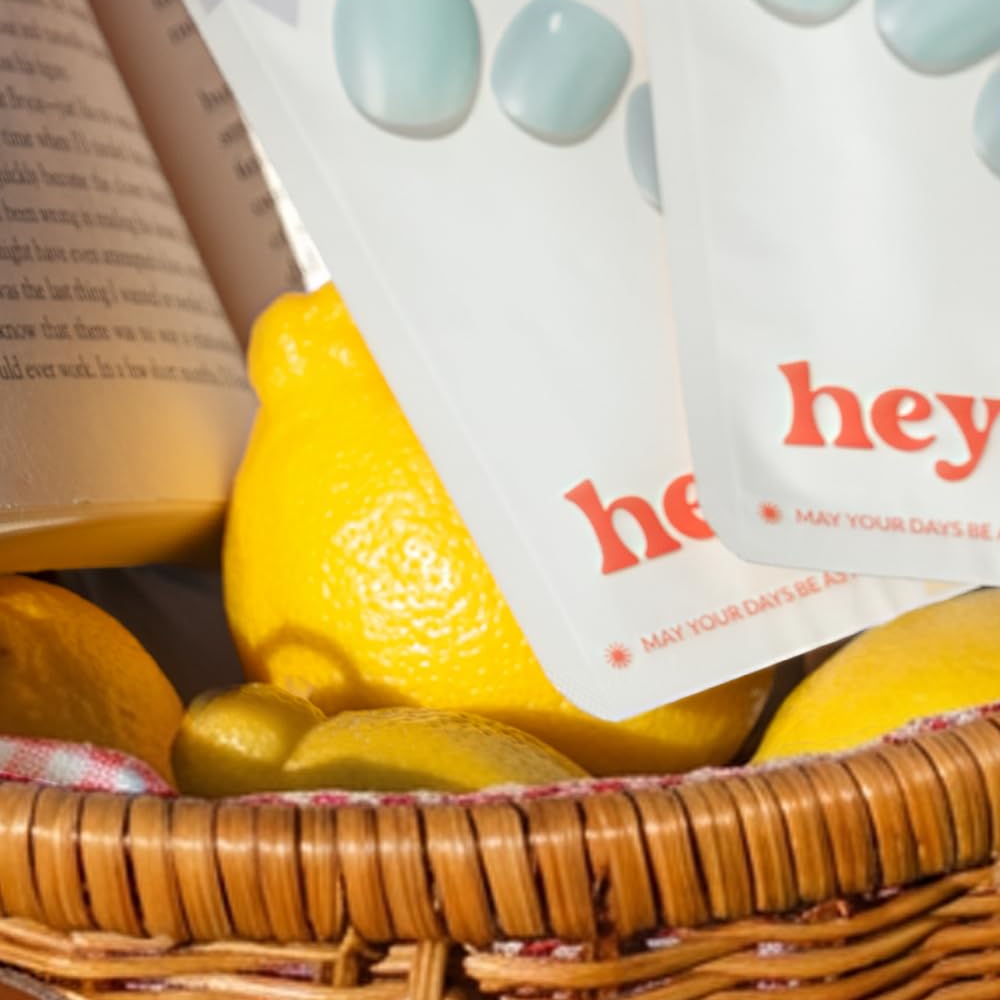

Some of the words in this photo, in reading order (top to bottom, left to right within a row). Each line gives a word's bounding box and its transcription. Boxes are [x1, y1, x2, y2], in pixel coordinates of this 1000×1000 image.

[795, 508, 841, 528] MAY
[846, 512, 905, 535] YOUR
[909, 516, 964, 538] DAYS
[967, 522, 993, 541] BE
[641, 625, 686, 653] MAY
[687, 604, 744, 636] YOUR
[742, 585, 796, 617] DAYS
[794, 575, 822, 599] BE
